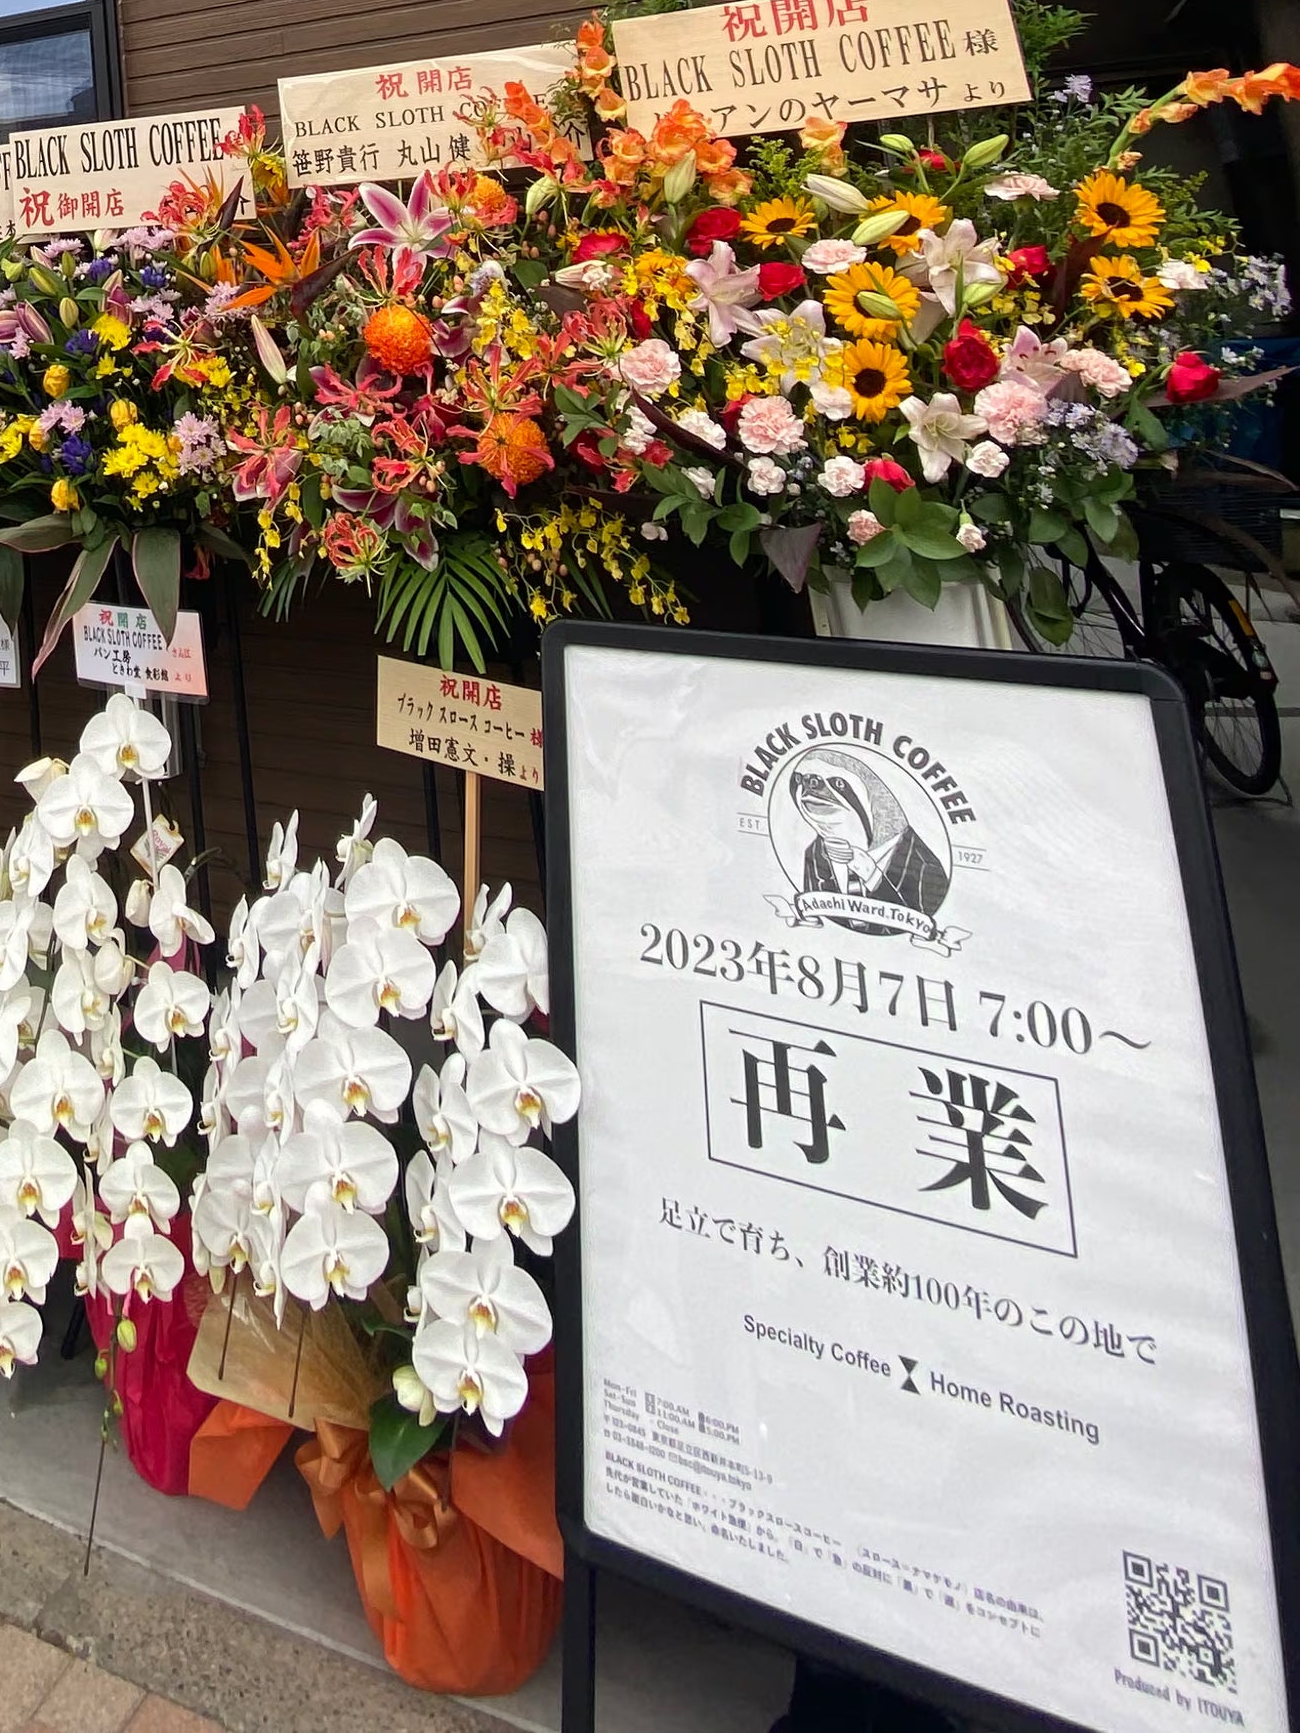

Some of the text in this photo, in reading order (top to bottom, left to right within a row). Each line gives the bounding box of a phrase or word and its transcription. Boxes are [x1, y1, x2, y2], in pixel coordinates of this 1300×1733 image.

[626, 55, 713, 102] BLACK
[729, 39, 821, 89] SLOTH
[840, 19, 956, 74] COFFEE
[295, 115, 360, 138] BLACK
[376, 105, 445, 129] SLOTH
[15, 118, 225, 180] BLACK SLOTH COFFEE
[292, 142, 380, 178] 笹野貴行
[84, 626, 106, 643] BLACK
[107, 629, 130, 647] SLOTH
[132, 631, 163, 651] COFFEE
[440, 674, 502, 711] 祝開店
[740, 712, 976, 825] BLACK SLOTH COFFEE
[957, 850, 983, 864] 1927
[803, 896, 845, 912] Adachi
[640, 922, 957, 1033] 2023年8月7日
[744, 1314, 1100, 1445] Specialty Coffee Home Roasting
[636, 1462, 666, 1483] SLOTH
